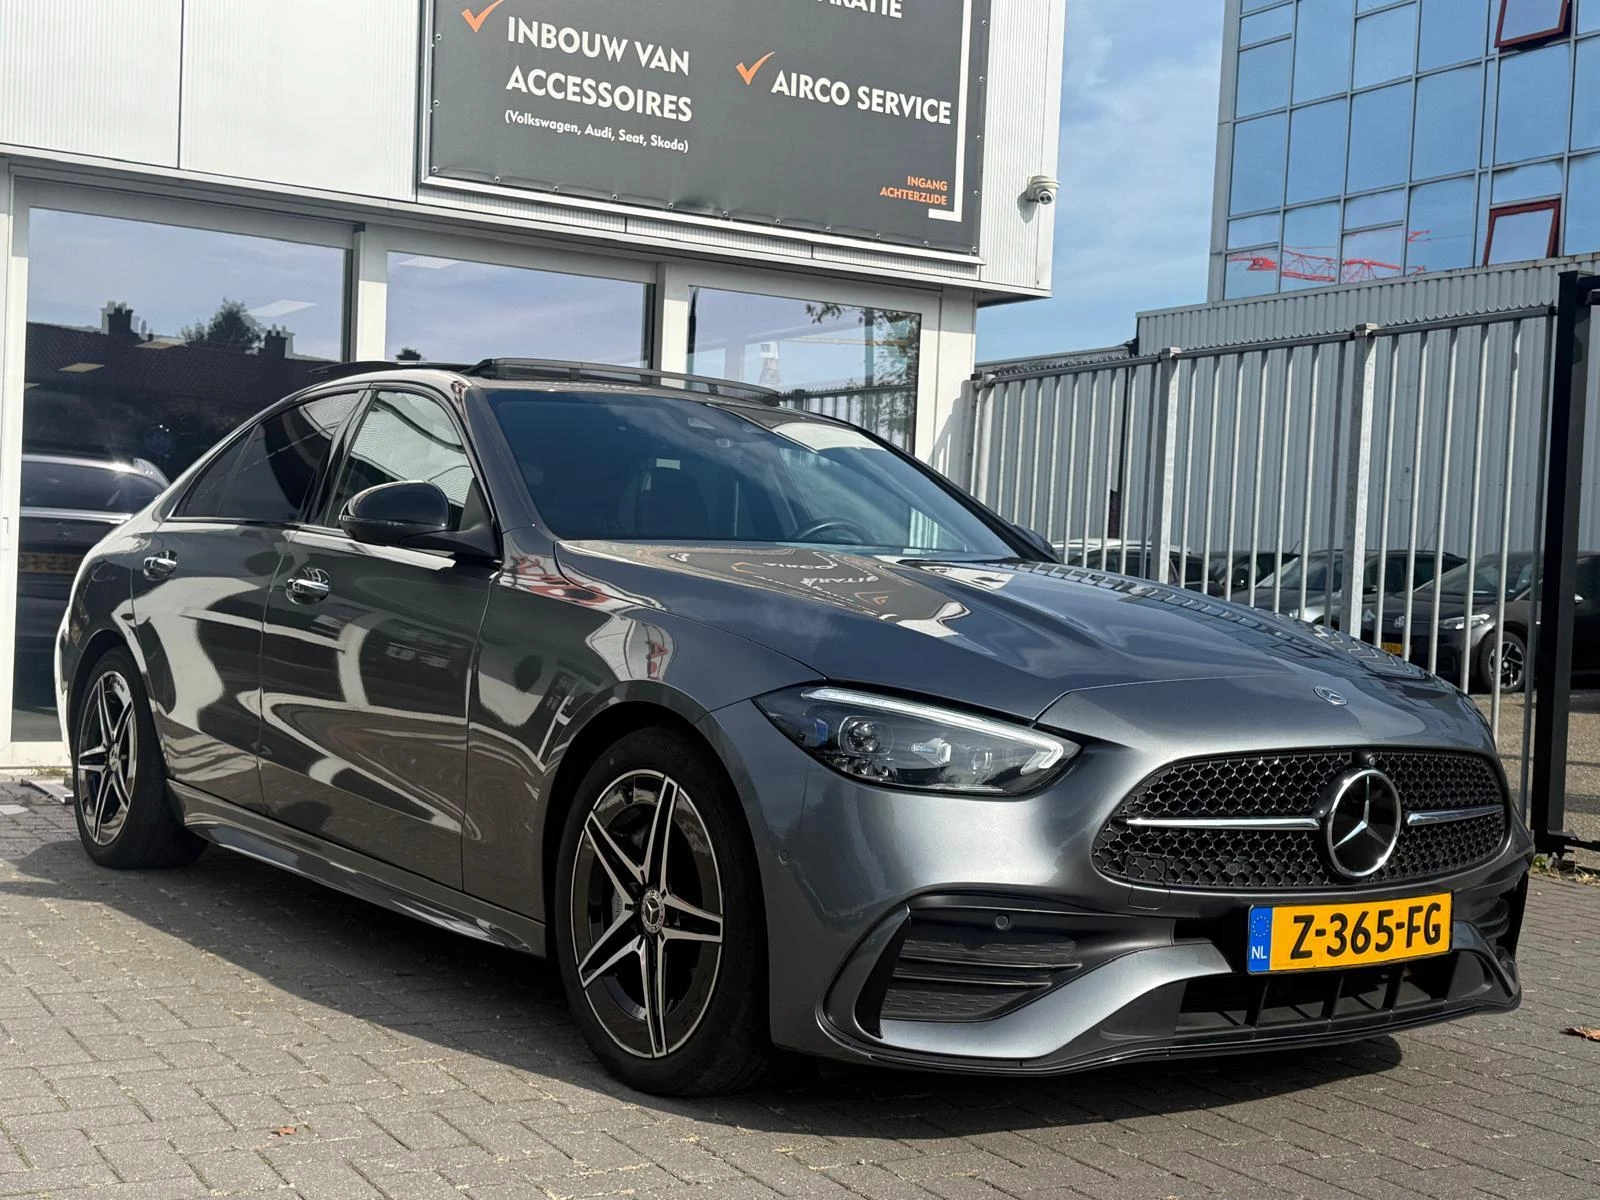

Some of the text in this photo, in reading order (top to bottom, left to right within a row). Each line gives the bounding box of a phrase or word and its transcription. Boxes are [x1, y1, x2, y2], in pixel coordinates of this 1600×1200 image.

[507, 16, 690, 76] INBOUW VAN
[505, 65, 693, 122] ACCESSOIRES
[771, 70, 952, 124] AIRCO SERVICE
[504, 109, 690, 154] (Volkswagen, Audi, Seat, Skoda)
[906, 175, 948, 192] INGANG
[1250, 902, 1442, 961] NL Z-365-FG
